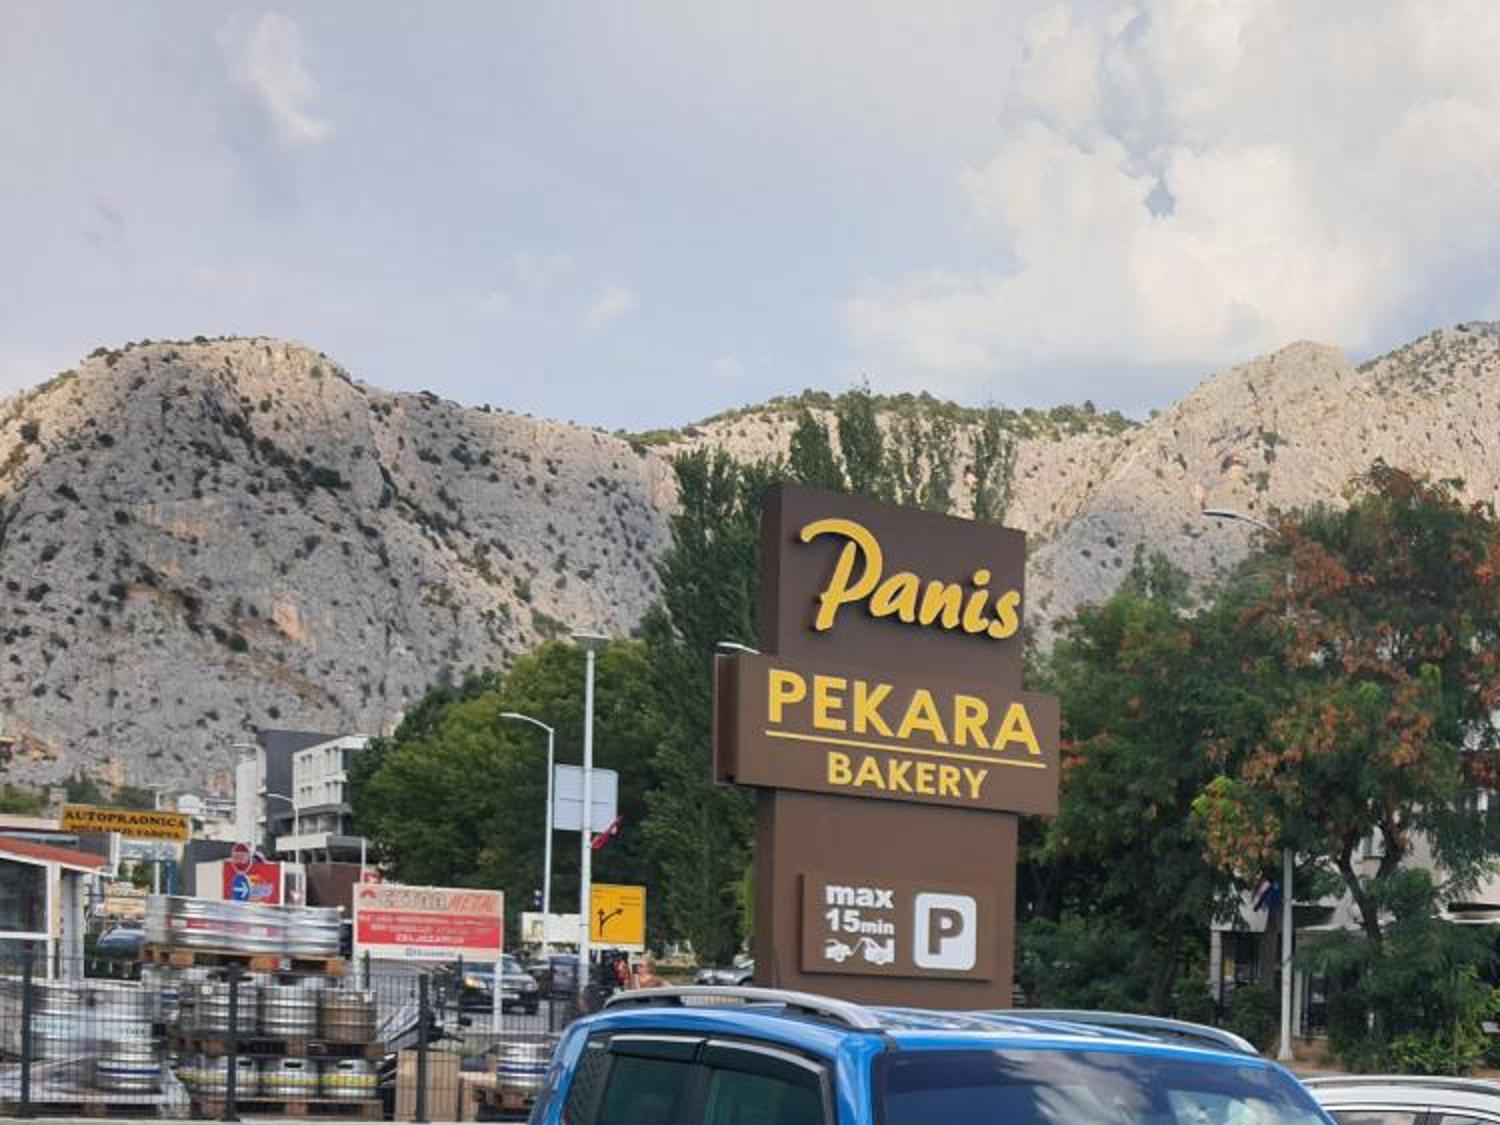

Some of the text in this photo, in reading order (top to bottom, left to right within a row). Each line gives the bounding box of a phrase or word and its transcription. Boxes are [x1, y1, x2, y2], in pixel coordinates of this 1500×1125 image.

[801, 517, 1021, 639] Panis
[768, 668, 1042, 756] PEKARA
[828, 751, 989, 800] BAKERY
[64, 810, 188, 829] AUTOPRAONICA
[825, 885, 895, 909] max
[927, 907, 965, 956] P
